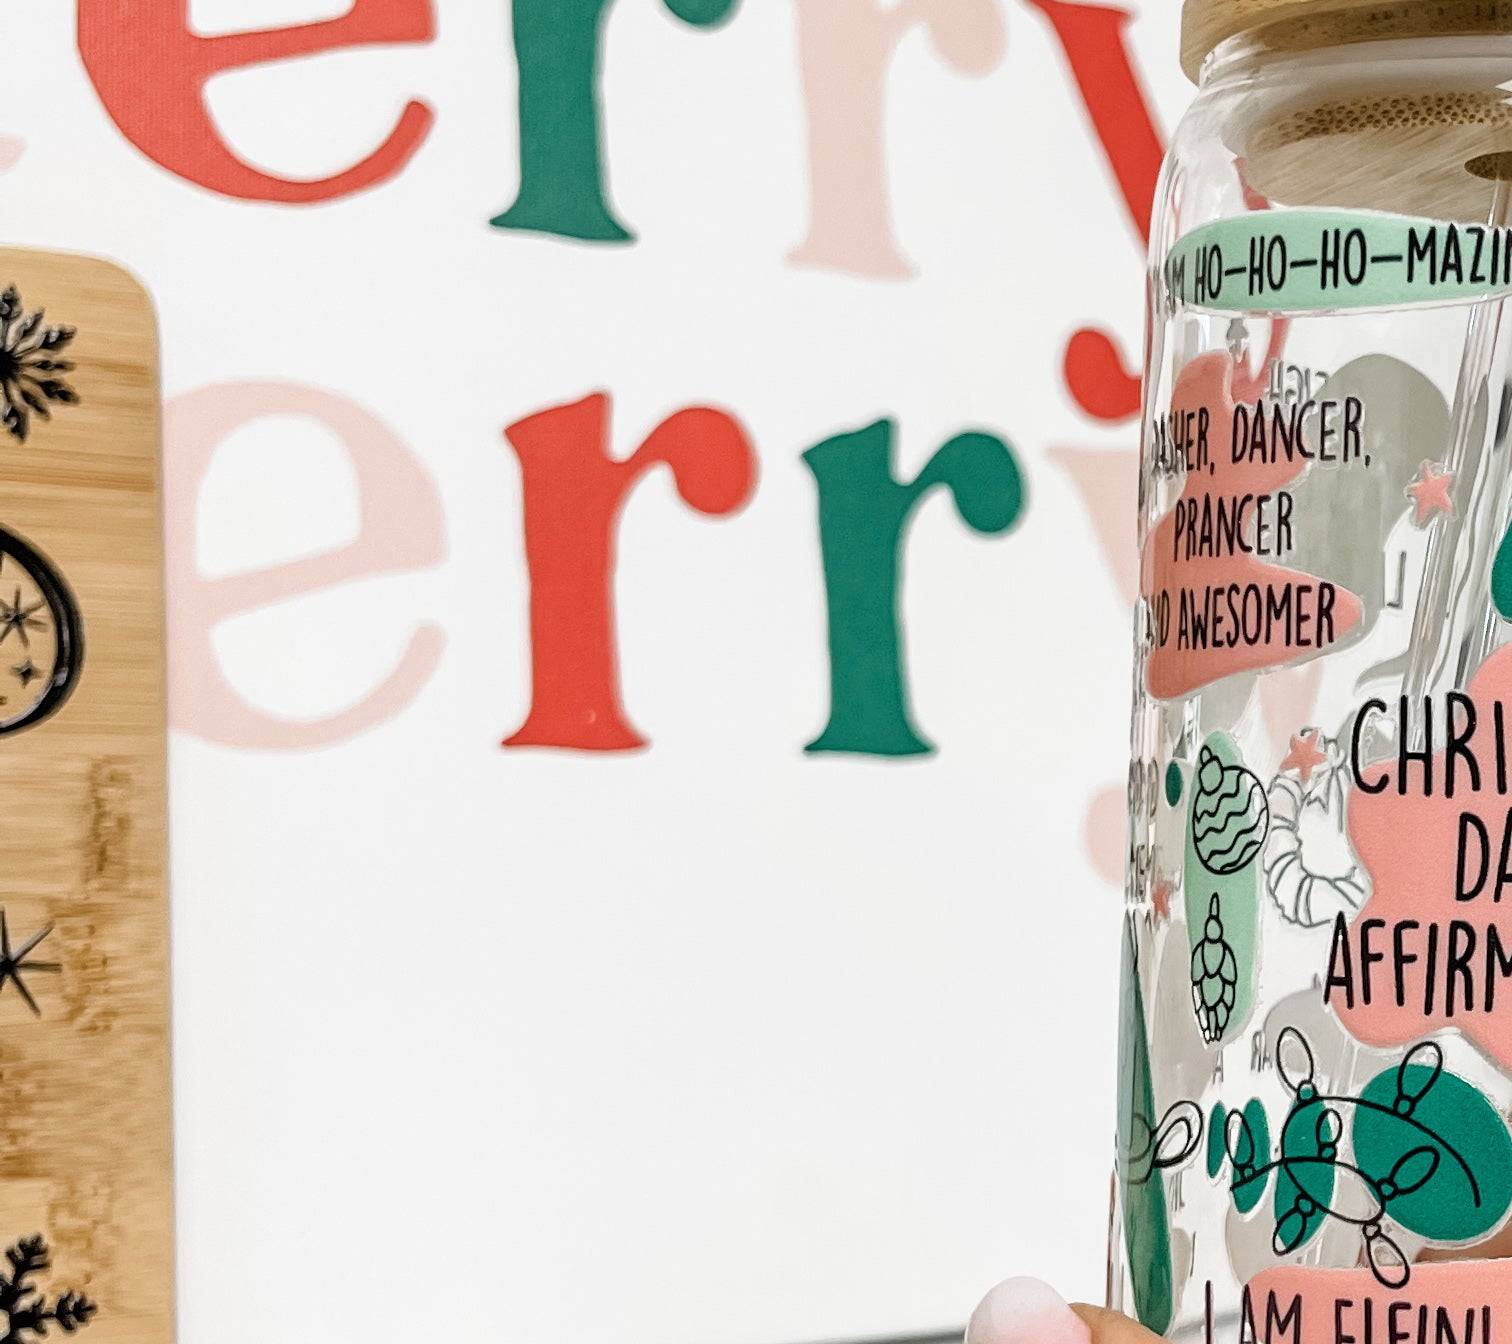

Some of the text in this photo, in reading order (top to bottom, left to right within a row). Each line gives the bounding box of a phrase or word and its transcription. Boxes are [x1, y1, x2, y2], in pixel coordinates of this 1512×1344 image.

[1232, 396, 1371, 469] DANCER,
[1174, 492, 1294, 562] PRANCER
[1177, 582, 1336, 651] AWESOMER
